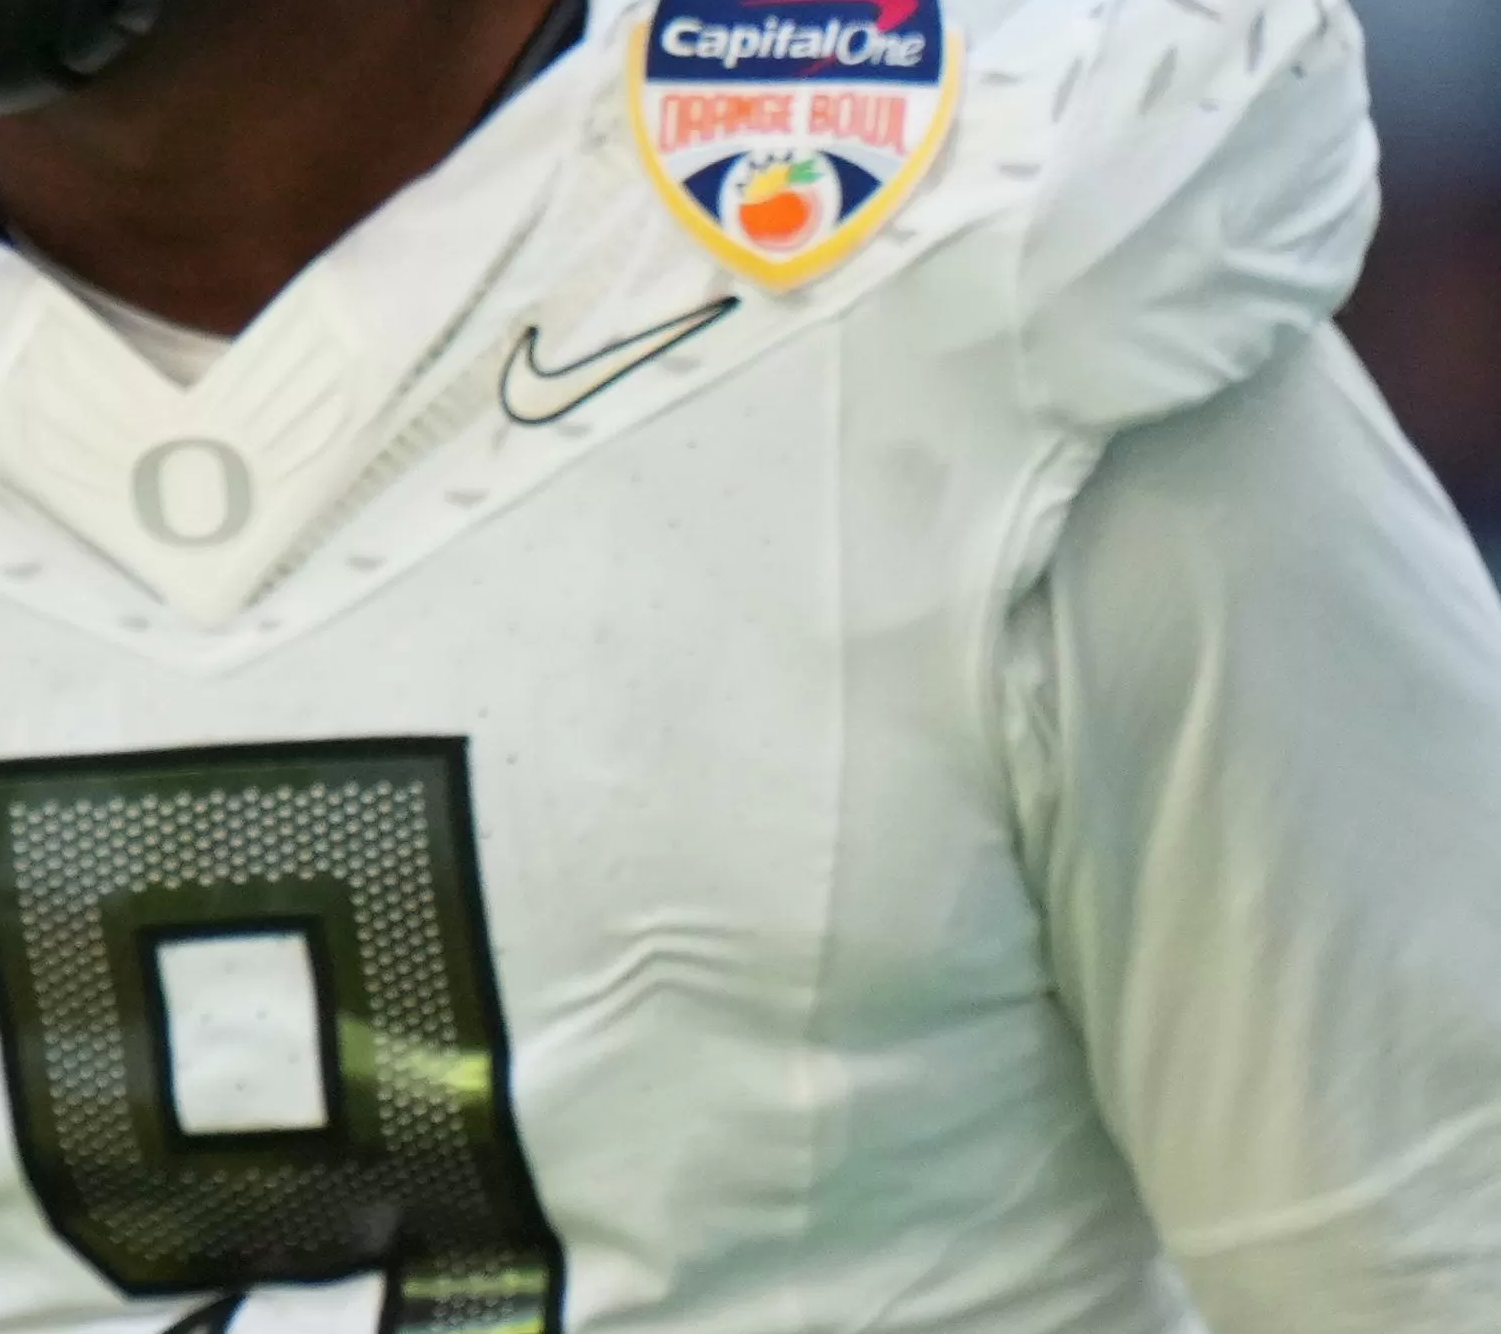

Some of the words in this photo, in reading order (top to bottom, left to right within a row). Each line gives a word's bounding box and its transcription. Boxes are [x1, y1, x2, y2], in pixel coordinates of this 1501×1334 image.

[660, 94, 795, 152] ORANGE
[809, 93, 907, 154] BOWL
[132, 437, 254, 548] O
